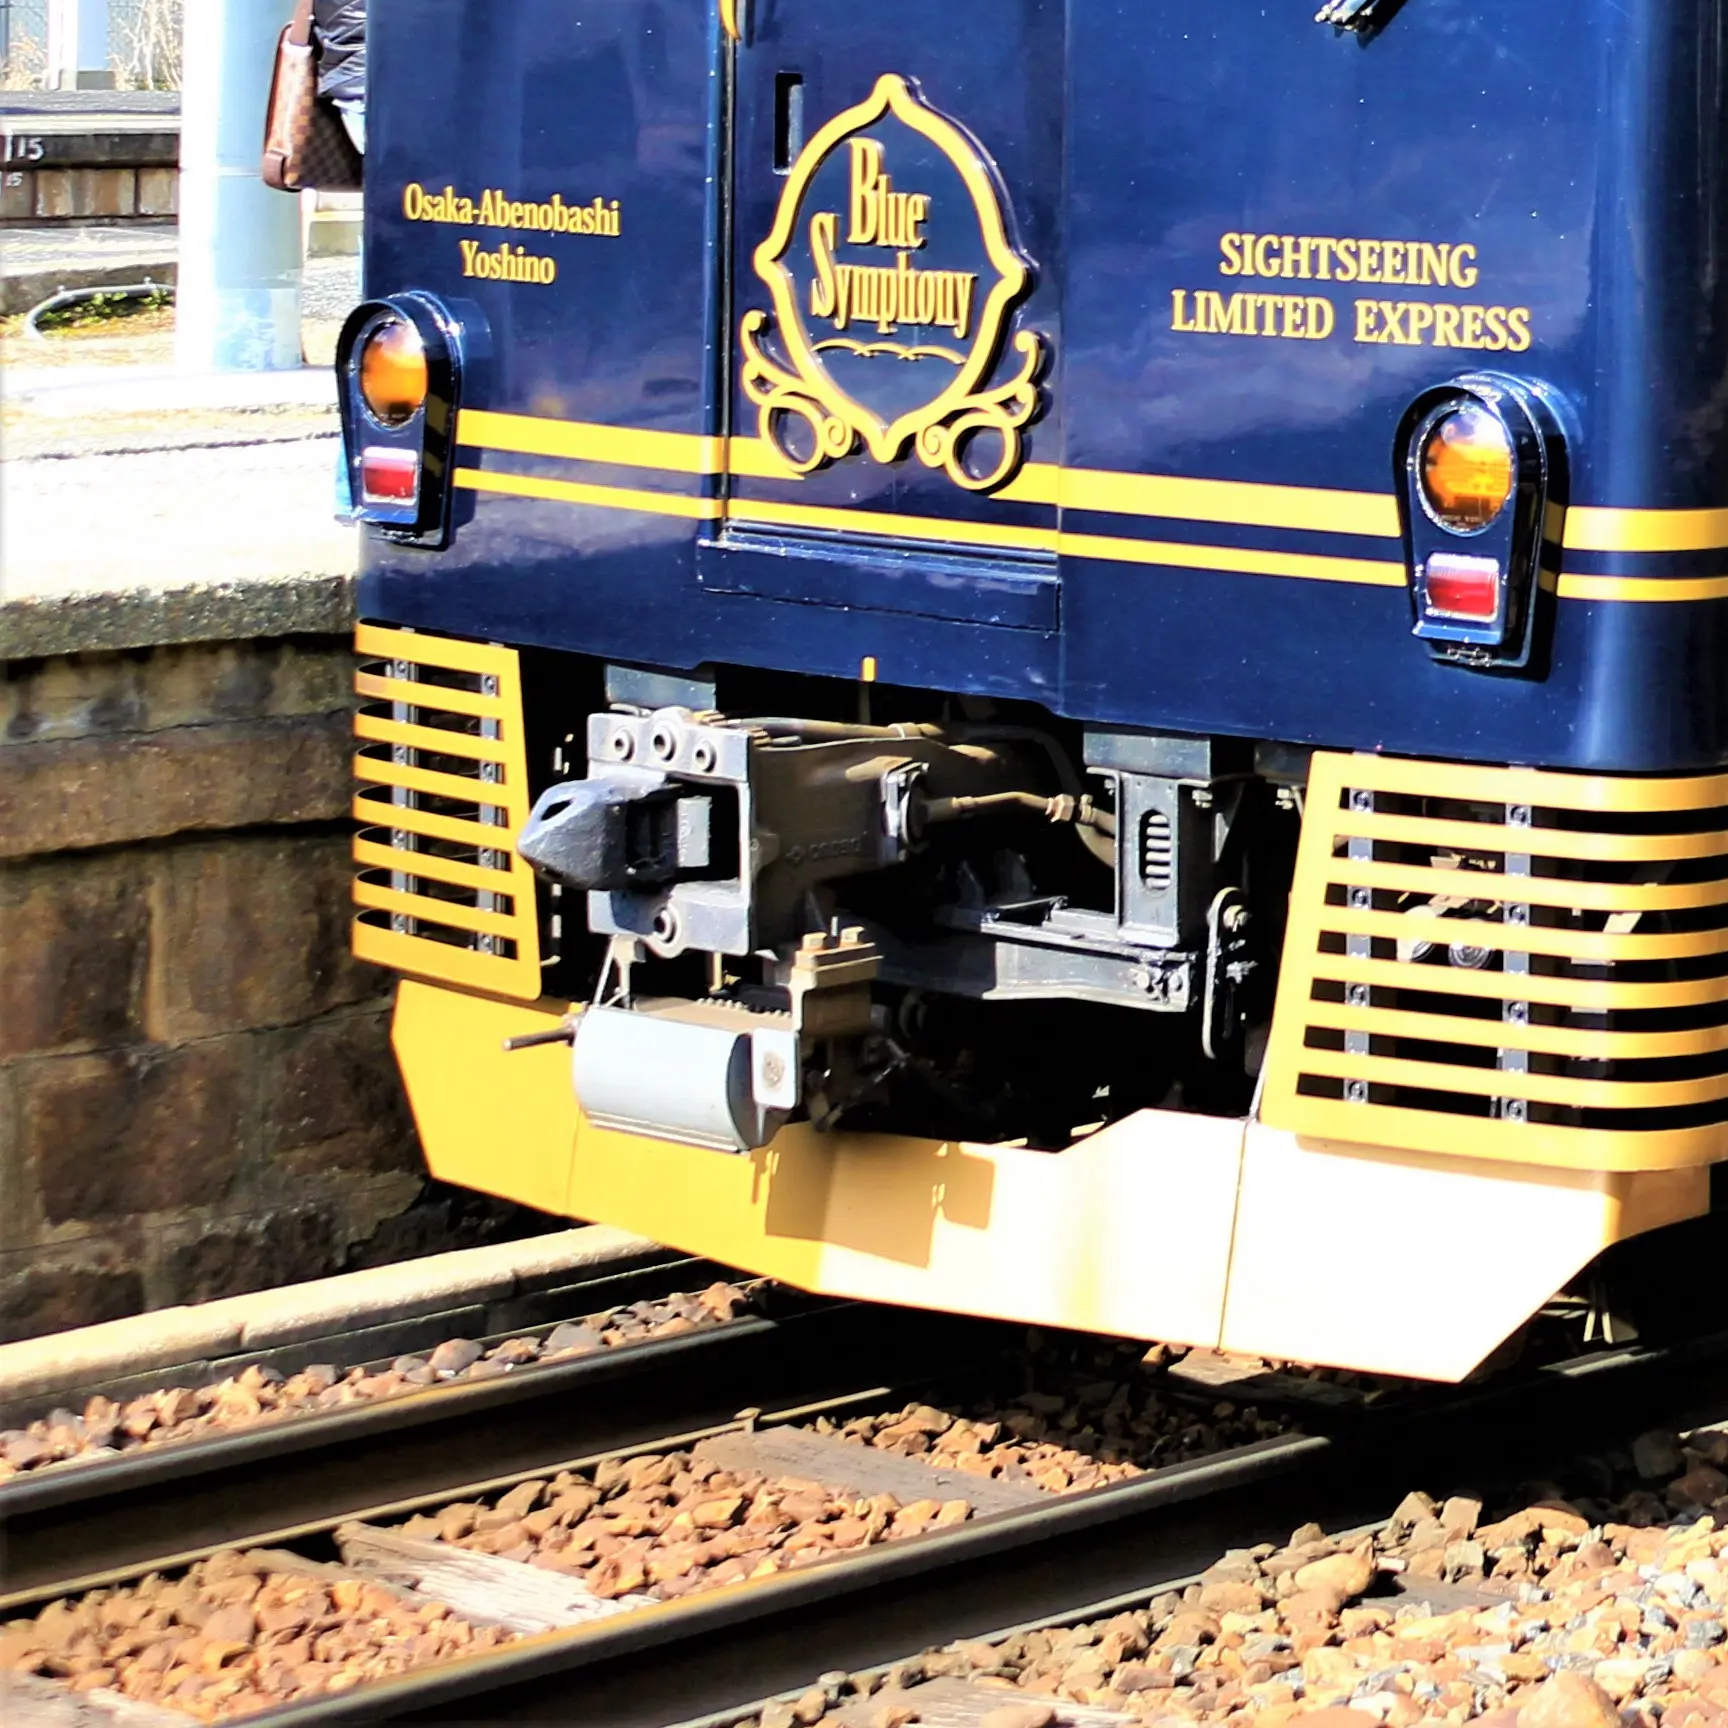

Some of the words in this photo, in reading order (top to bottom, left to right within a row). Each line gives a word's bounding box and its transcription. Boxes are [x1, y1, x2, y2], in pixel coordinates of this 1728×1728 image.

[403, 183, 621, 236] Osaka-Abenobashi
[847, 136, 931, 249] Blue
[459, 239, 557, 284] Yoshino
[810, 211, 978, 340] Symphony
[1219, 232, 1478, 288] SIGHTSEEING
[1171, 289, 1335, 340] LIMITED
[1354, 299, 1532, 352] EXPRESS
